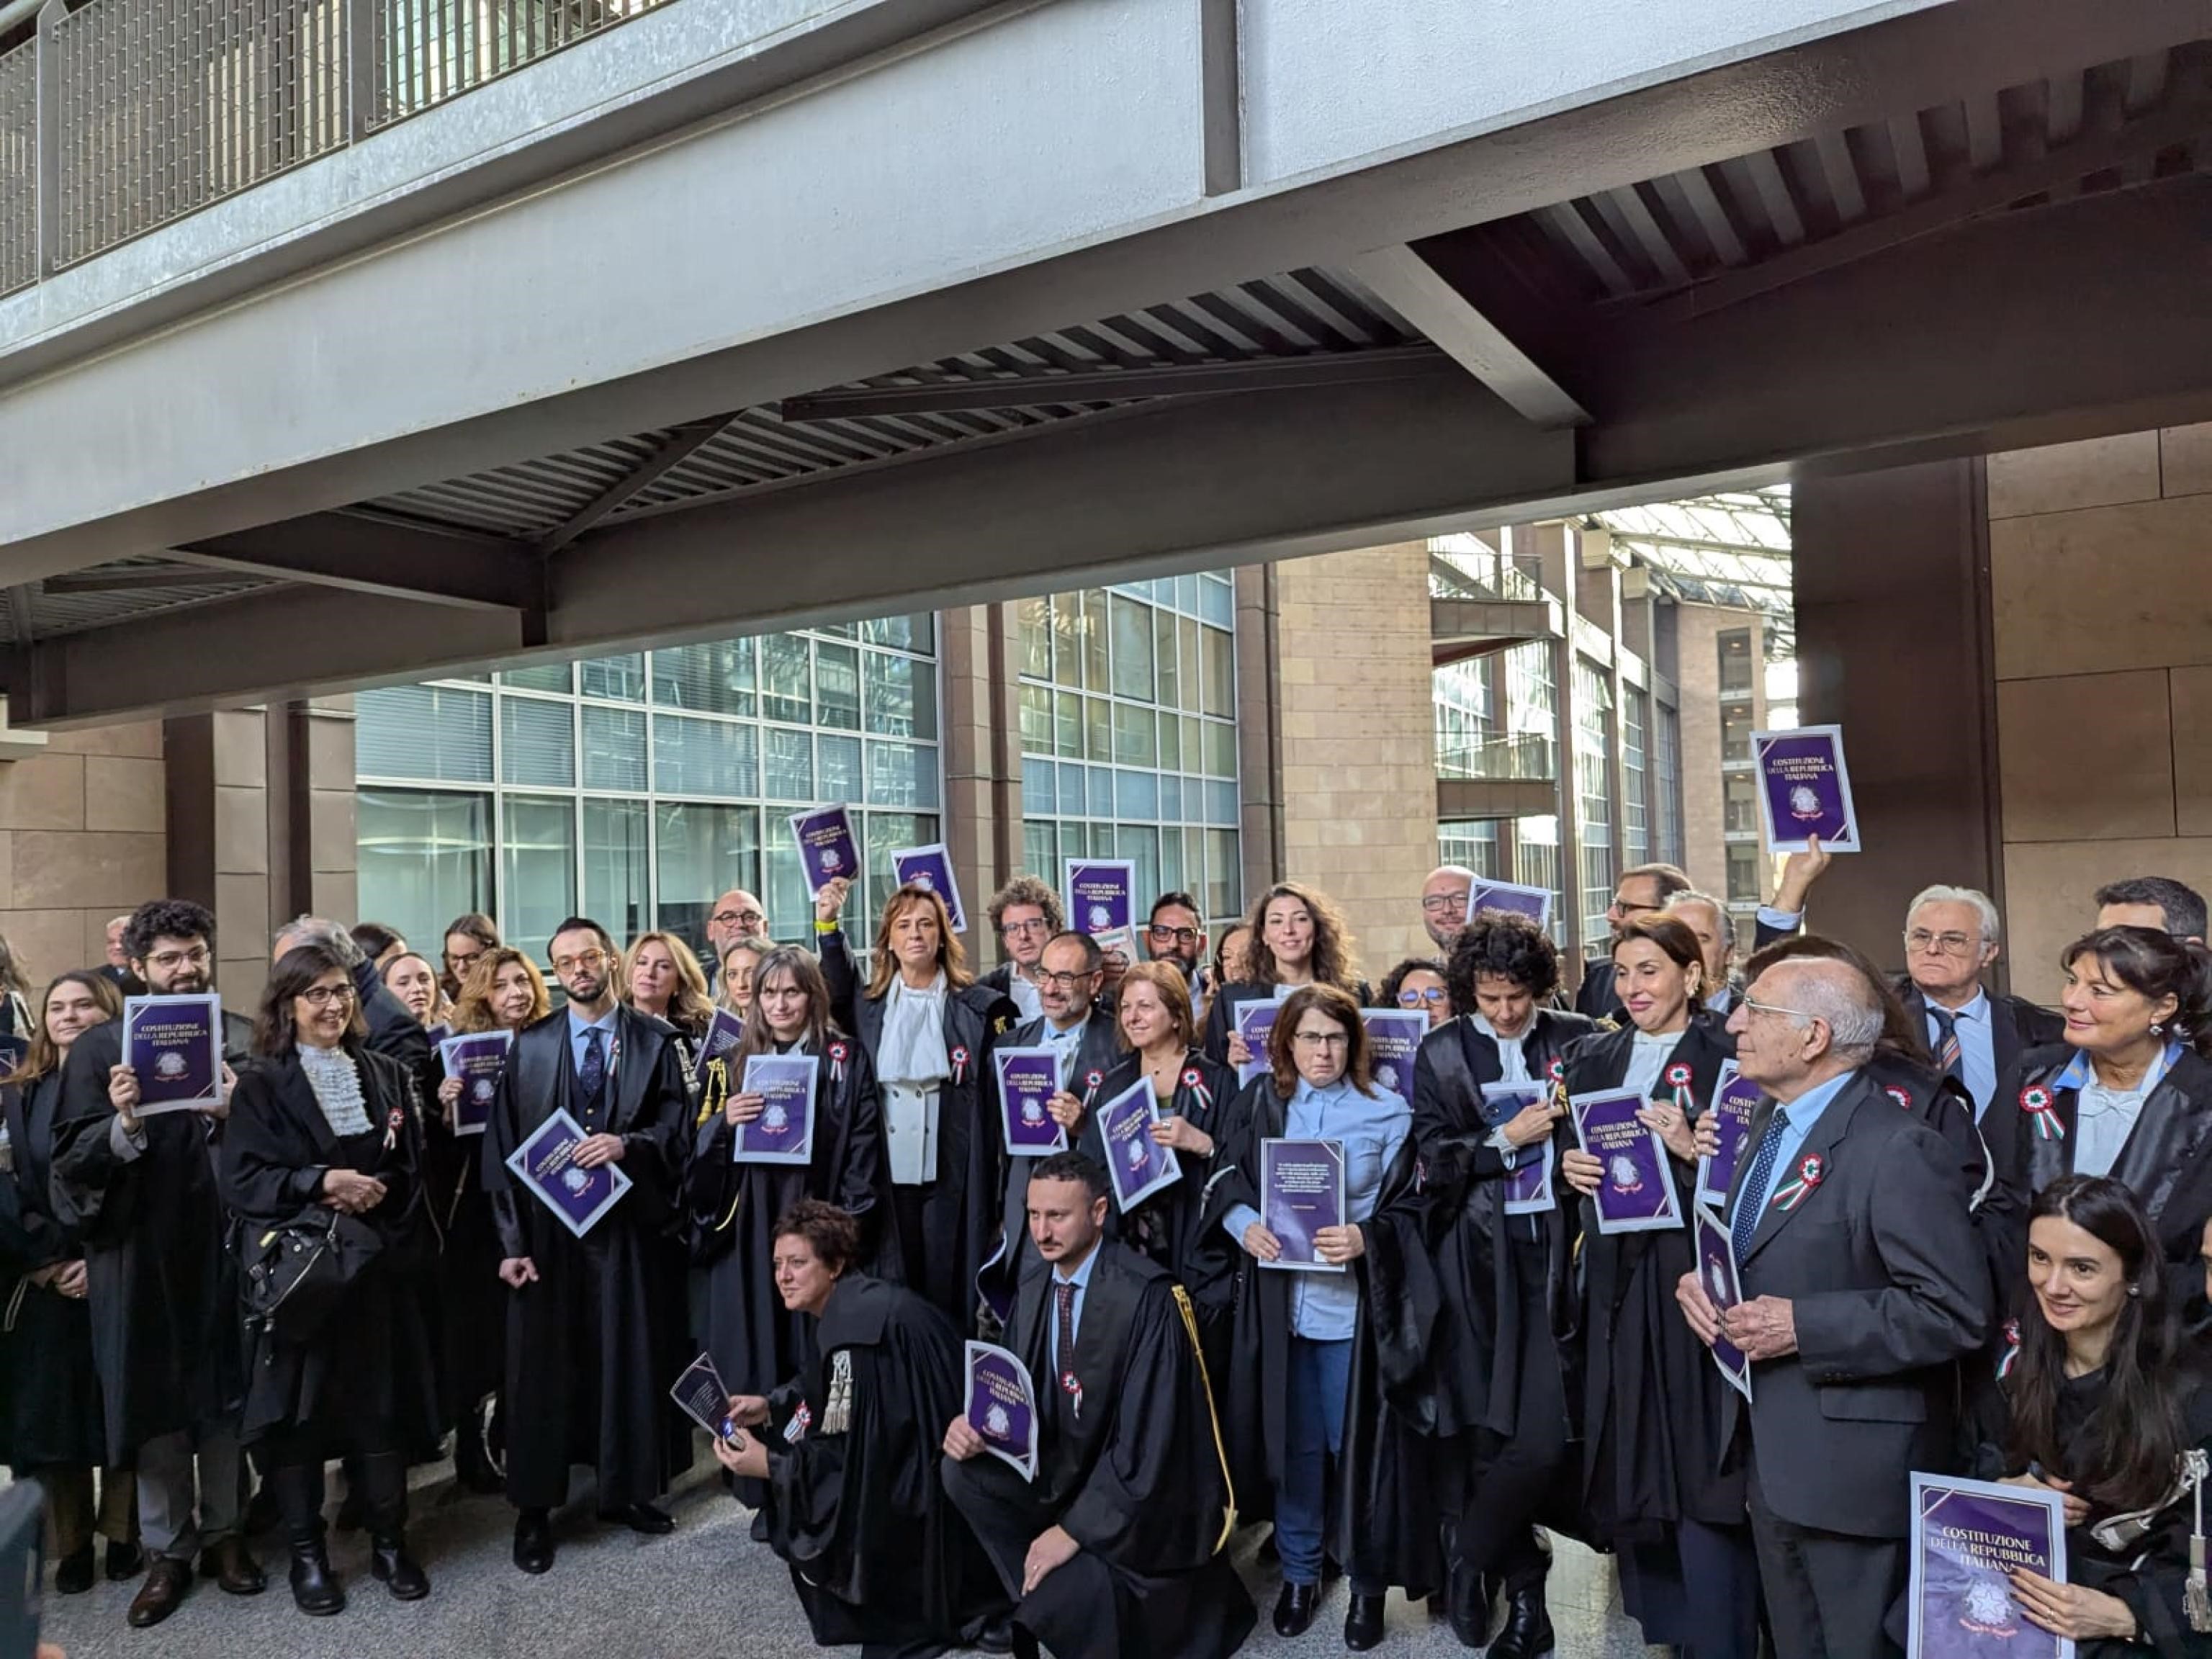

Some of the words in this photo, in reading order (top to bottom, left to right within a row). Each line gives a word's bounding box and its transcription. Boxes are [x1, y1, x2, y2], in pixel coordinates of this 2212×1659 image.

[1772, 757, 1825, 767] COSTITUZIONE
[140, 1023, 199, 1032] COSTITUZIONE
[158, 1030, 208, 1039] REPUBBLICA
[1591, 1120, 1637, 1135] COSTITUZIONE
[1605, 1128, 1649, 1141] REPUBBLICA
[1601, 1139, 1635, 1150] ITALIANA
[1942, 1526, 2033, 1551] COSTITUZIONE
[1930, 1536, 1968, 1552] DELLA
[1969, 1543, 2046, 1568] REPUBBLICA
